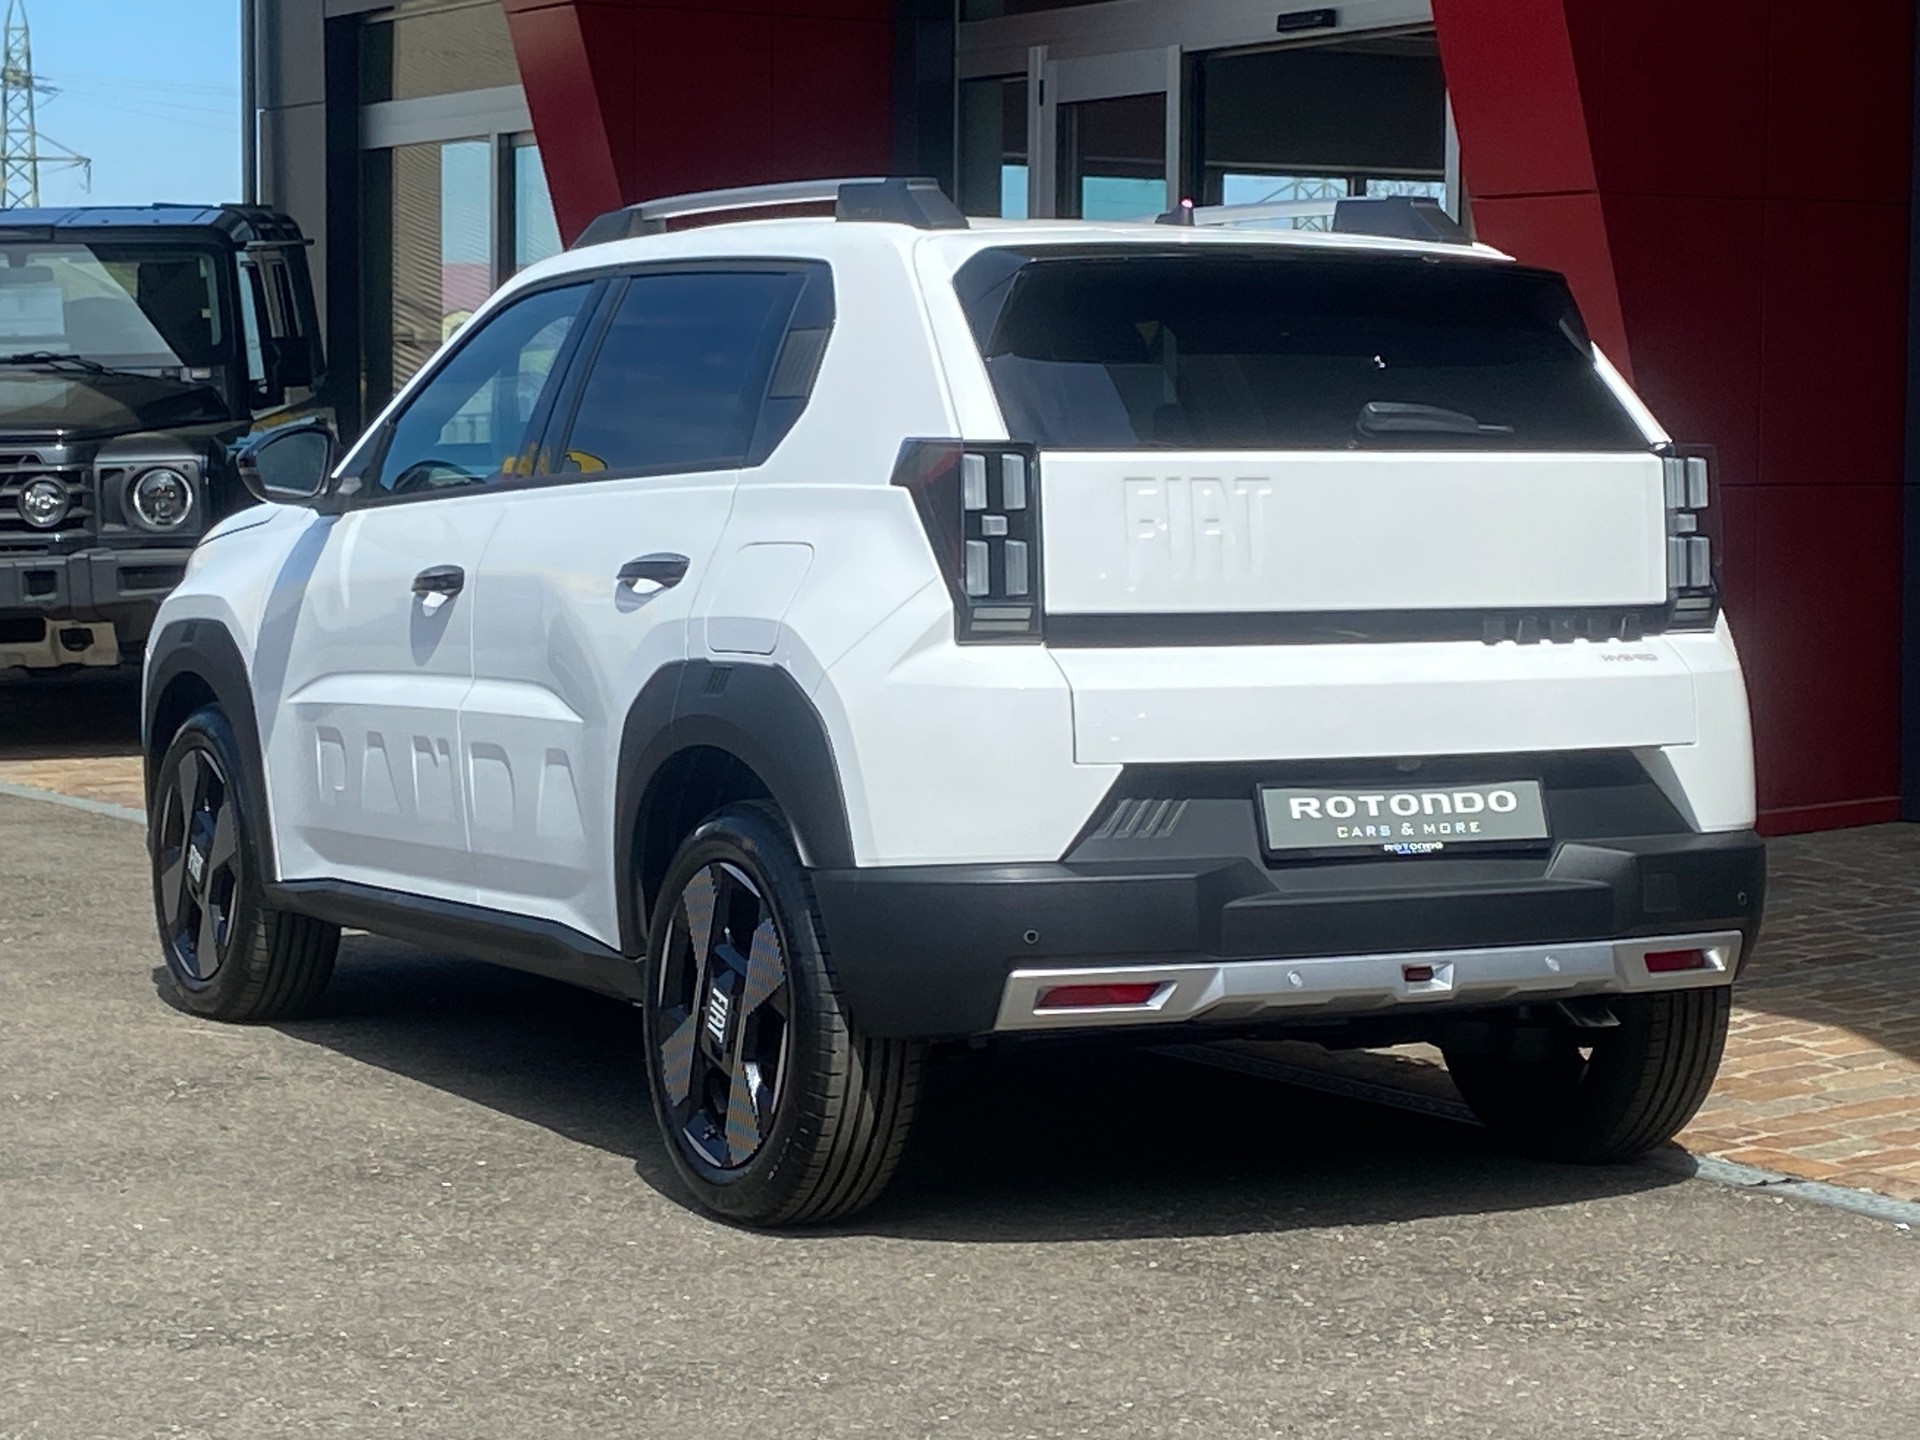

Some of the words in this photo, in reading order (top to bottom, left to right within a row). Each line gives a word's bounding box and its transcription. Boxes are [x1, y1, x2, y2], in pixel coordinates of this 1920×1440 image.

[1123, 477, 1272, 583] FIAT
[1288, 789, 1518, 820] ROTONDO
[1336, 824, 1391, 839] CARS
[1401, 822, 1415, 836] &
[1422, 820, 1482, 836] MORE
[706, 987, 729, 1044] FIAT
